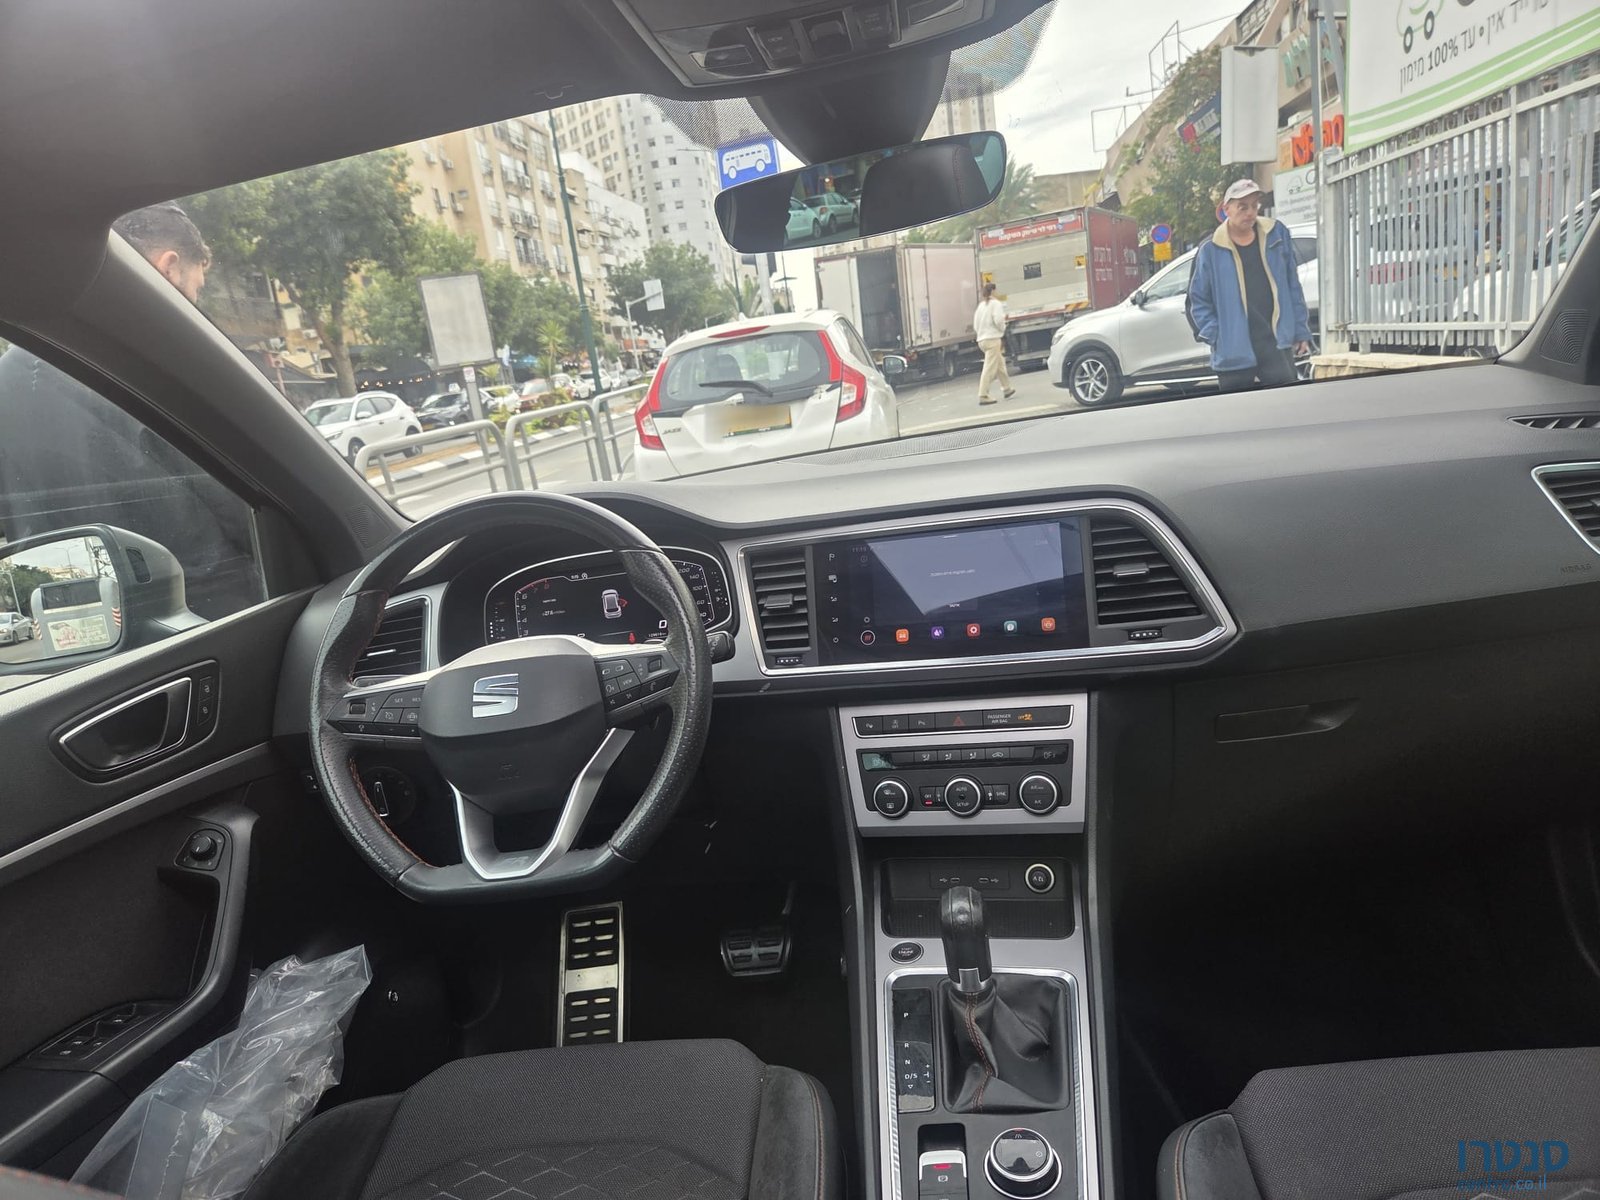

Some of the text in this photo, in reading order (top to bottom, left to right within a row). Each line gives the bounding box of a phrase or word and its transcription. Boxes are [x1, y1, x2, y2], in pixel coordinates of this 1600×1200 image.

[1460, 25, 1476, 51] עד
[1487, 8, 1505, 45] אין
[1427, 35, 1459, 71] 100%
[1400, 57, 1424, 93] מימון
[662, 427, 682, 435] JAZZ
